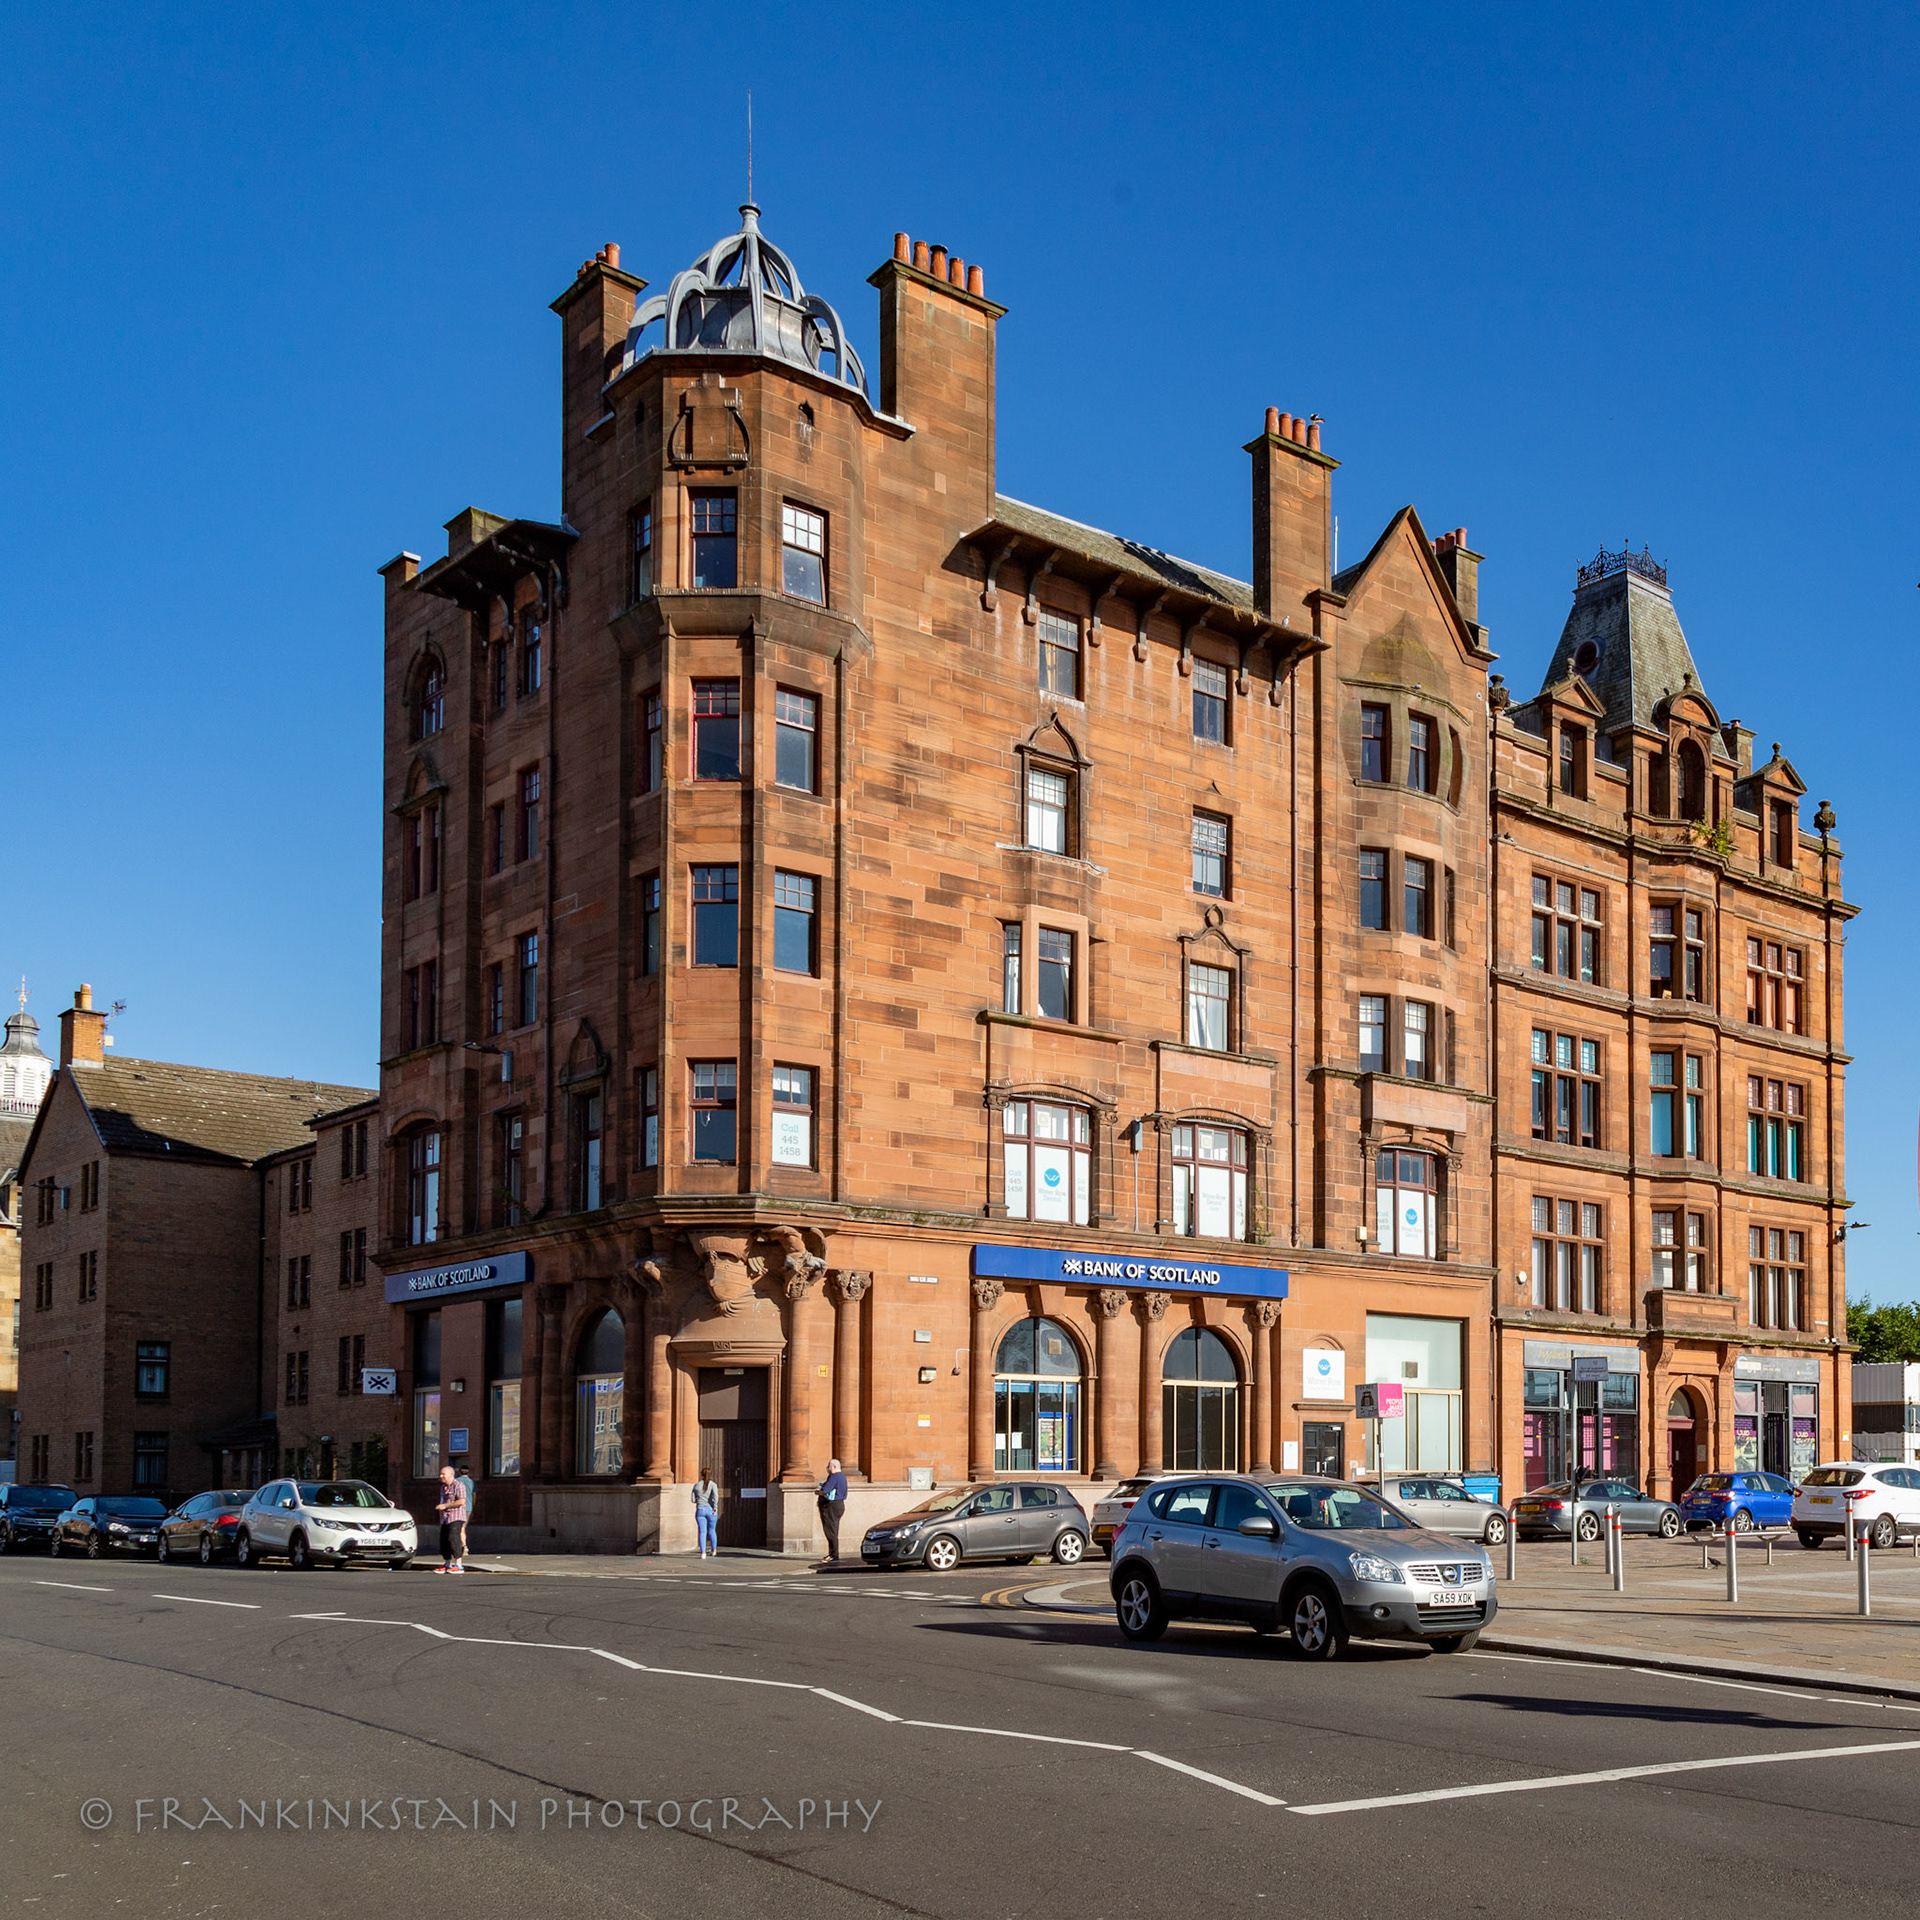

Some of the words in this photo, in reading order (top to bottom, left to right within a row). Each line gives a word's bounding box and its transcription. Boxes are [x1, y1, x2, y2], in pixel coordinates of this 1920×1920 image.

[781, 1123, 799, 1133] Call
[781, 1135, 799, 1144] 445
[779, 1146, 801, 1156] 1458
[417, 1274, 437, 1290] BANK
[437, 1272, 449, 1287] OF
[450, 1265, 490, 1285] SCOTLAND
[1084, 1260, 1124, 1278] BANK
[1126, 1263, 1147, 1279] OF
[1149, 1265, 1221, 1285] SCOTLAND
[1669, 1400, 1675, 1410] 7
[1433, 1592, 1456, 1604] SA59
